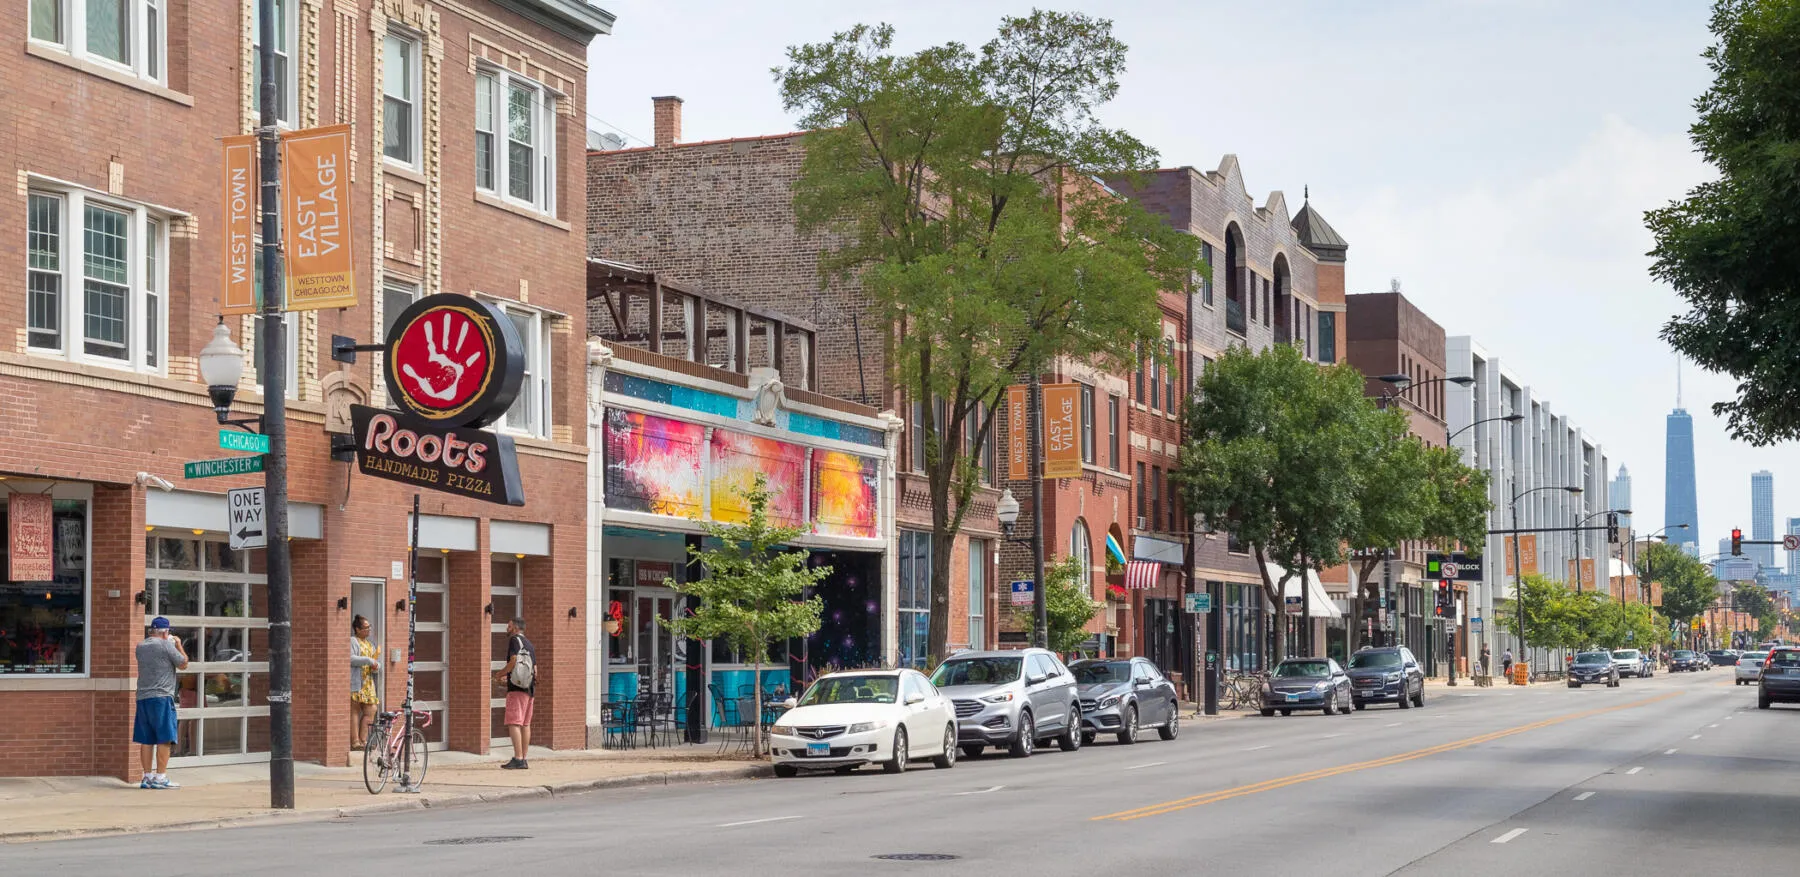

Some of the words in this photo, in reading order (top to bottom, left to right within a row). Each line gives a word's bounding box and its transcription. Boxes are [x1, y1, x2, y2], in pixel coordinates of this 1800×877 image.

[232, 167, 246, 224] TOWN
[317, 153, 340, 256] VILLAGE
[297, 195, 317, 258] EAST
[232, 231, 246, 284] WEST
[294, 285, 350, 297] CHICAGO.COM
[298, 275, 345, 285] WESTTOWN
[1014, 402, 1022, 433] TOWN
[1062, 397, 1073, 450] VILLAGE
[228, 433, 260, 451] CHICAGO
[1014, 436, 1023, 464] WEST
[1050, 418, 1061, 452] EAST
[194, 458, 252, 476] WINCHESTER
[365, 455, 440, 483] HANDMADE
[446, 473, 492, 495] PIZZA
[233, 492, 261, 507] ONE
[233, 508, 262, 523] WAY
